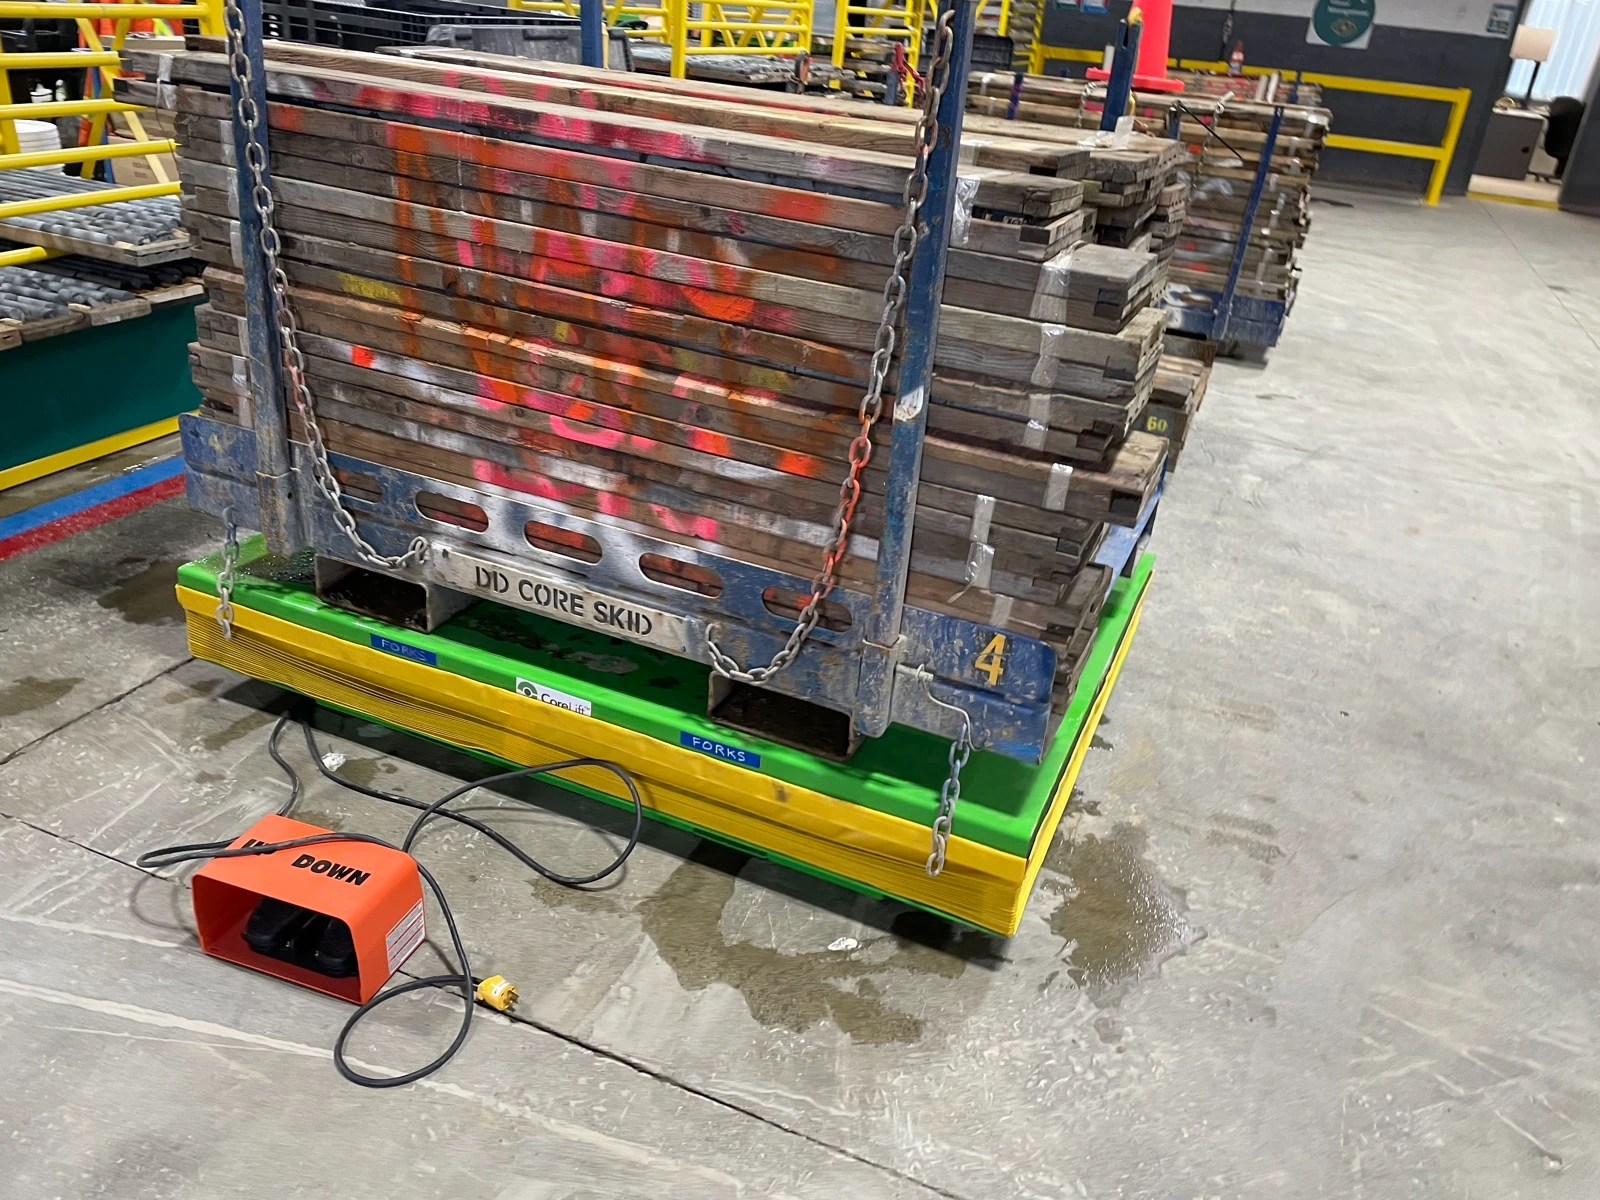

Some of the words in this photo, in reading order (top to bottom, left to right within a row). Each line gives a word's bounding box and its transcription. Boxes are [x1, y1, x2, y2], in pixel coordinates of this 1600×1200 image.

[1147, 415, 1168, 432] 60
[475, 565, 509, 594] DD
[518, 579, 584, 617] CORE
[593, 600, 652, 636] SKID
[381, 638, 427, 662] FORKS
[974, 633, 1006, 686] 4
[692, 736, 746, 762] FORKS
[291, 853, 371, 886] DOWN
